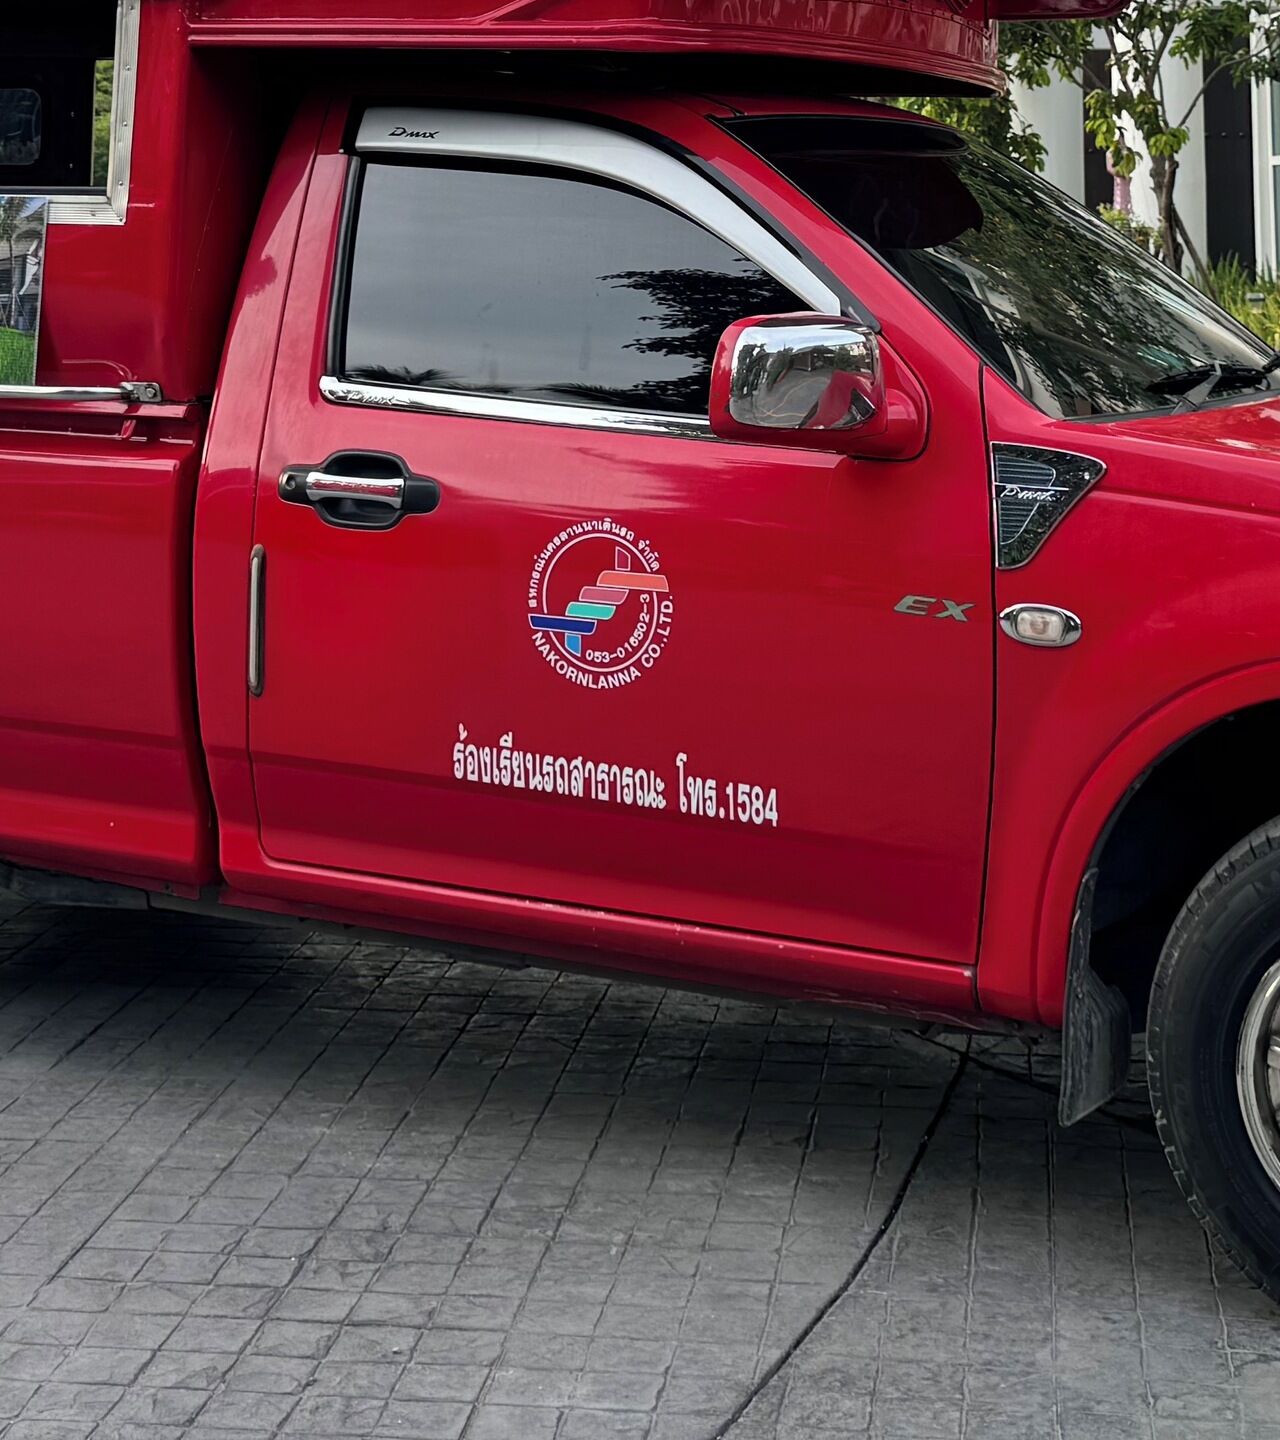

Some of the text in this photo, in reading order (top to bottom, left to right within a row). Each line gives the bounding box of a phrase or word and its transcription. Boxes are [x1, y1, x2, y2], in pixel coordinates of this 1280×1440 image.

[638, 540, 660, 572] จำกัด
[893, 594, 976, 622] EX
[532, 631, 642, 690] NAKORNLANNA
[453, 722, 779, 827] ร้องเรียนรถสาธารณะ โทร.1584
